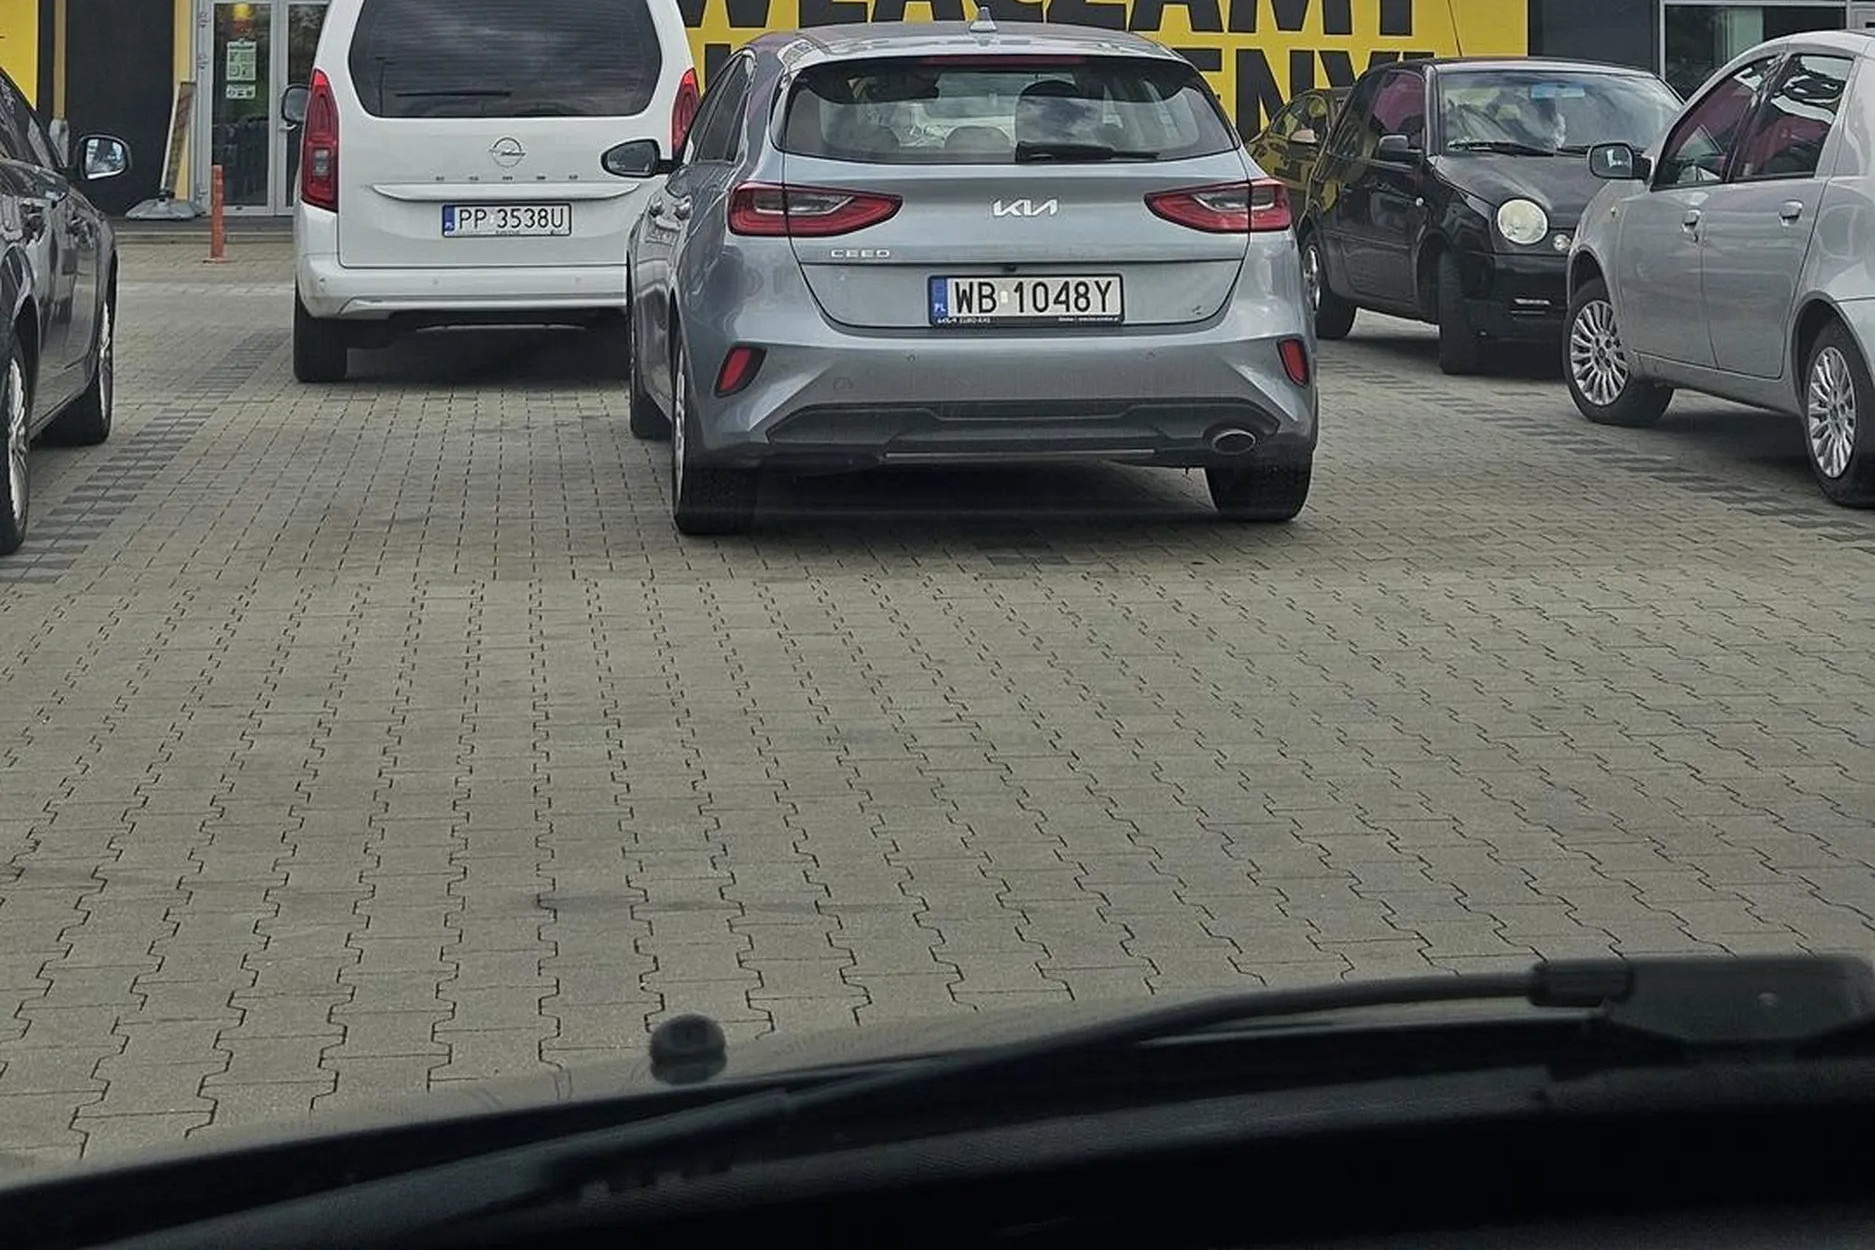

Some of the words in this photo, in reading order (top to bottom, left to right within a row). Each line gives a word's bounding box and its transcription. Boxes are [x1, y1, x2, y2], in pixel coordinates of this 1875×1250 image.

[992, 199, 1059, 217] KIA
[459, 208, 488, 230] PP
[496, 207, 564, 229] 3538U
[830, 249, 891, 259] CEED
[954, 280, 998, 314] WB
[1013, 280, 1113, 313] 1048Y
